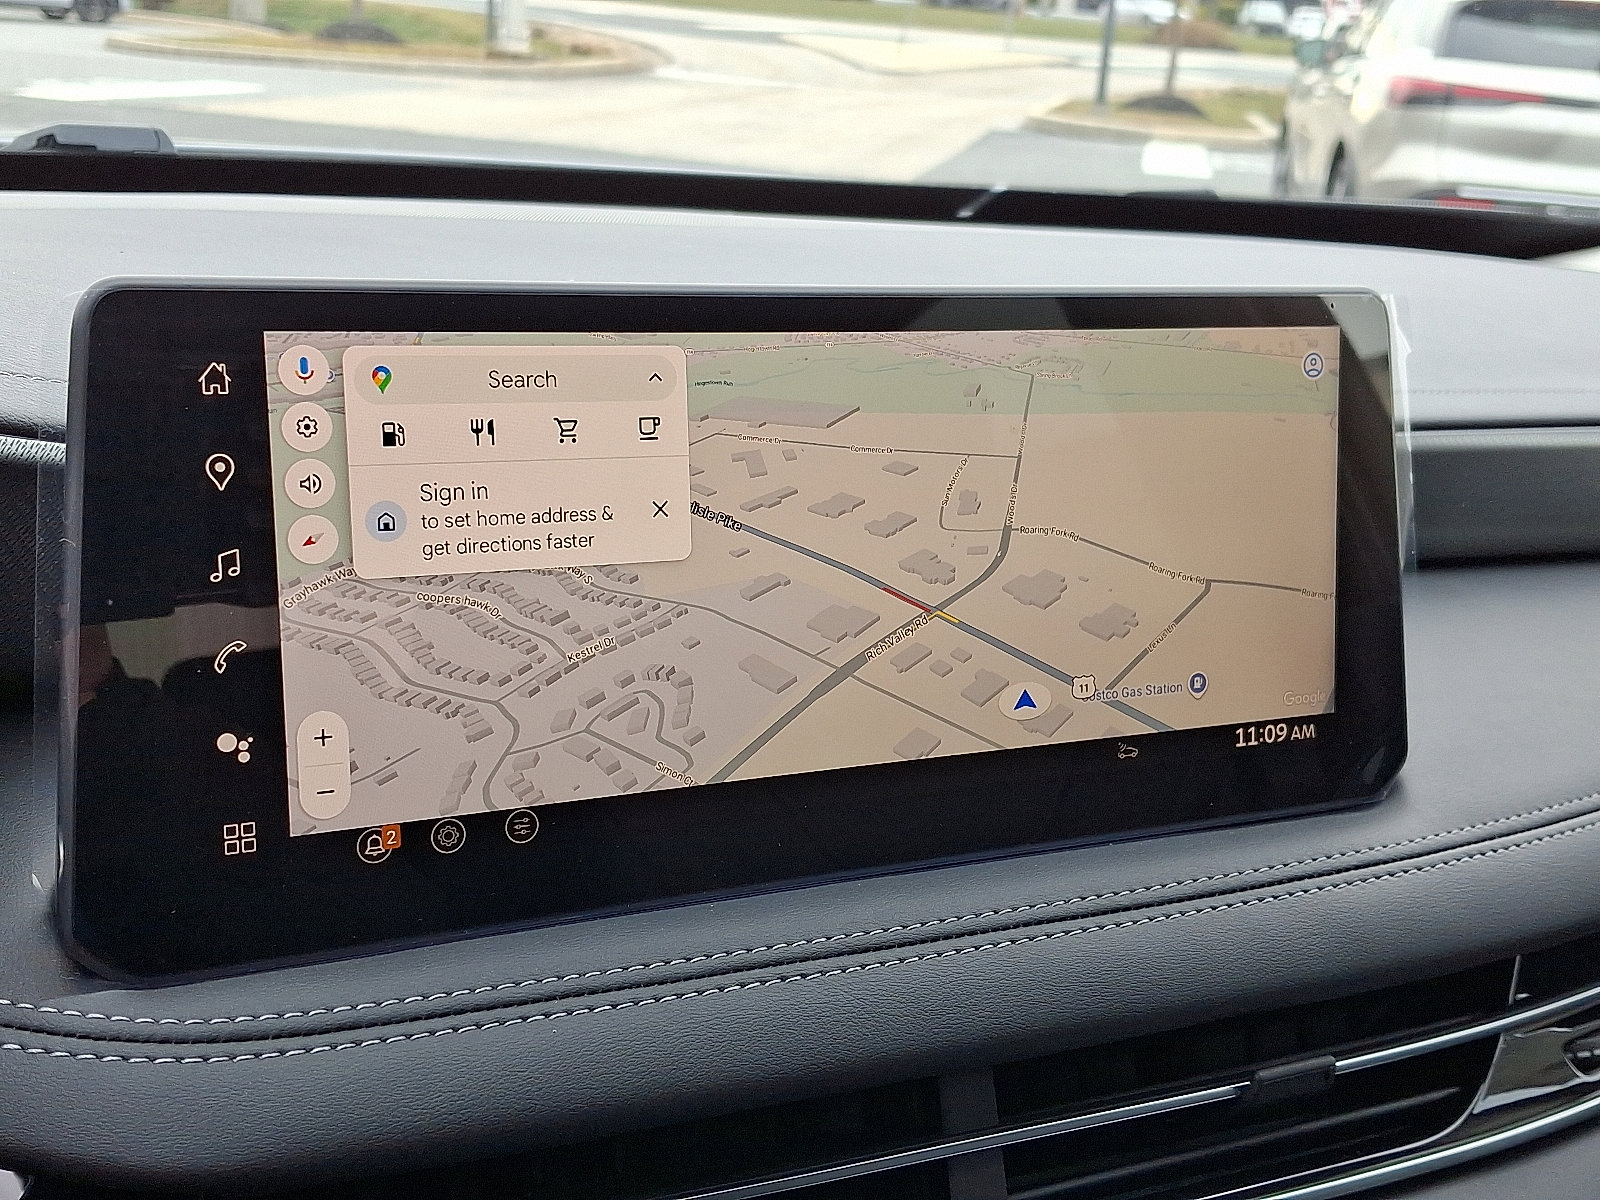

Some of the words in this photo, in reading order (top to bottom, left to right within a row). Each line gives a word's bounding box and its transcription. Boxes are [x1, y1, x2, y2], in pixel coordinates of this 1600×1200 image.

[488, 370, 557, 389] Search
[738, 433, 772, 444] Commerce
[850, 445, 884, 454] Commerce
[420, 483, 464, 506] Sign
[471, 481, 489, 500] in
[942, 493, 950, 506] Sun
[946, 466, 964, 492] Motors
[960, 458, 969, 467] Dr
[422, 514, 438, 530] to
[444, 512, 471, 528] set
[477, 510, 526, 528] home
[531, 506, 597, 524] address
[601, 506, 614, 522] &
[690, 501, 716, 521] lisle
[716, 512, 742, 532] Pike
[1007, 495, 1017, 524] Woods
[1020, 526, 1049, 536] Roaring
[1050, 527, 1069, 539] Fork
[1070, 532, 1080, 542] Rd
[422, 540, 451, 560] get
[456, 536, 542, 556] directions
[546, 533, 594, 551] faster
[584, 576, 593, 584] S
[1149, 562, 1176, 579] Roaring
[1177, 571, 1194, 582] Fork
[1195, 575, 1206, 585] Rd
[283, 574, 334, 609] Grayhawk
[1302, 588, 1328, 600] Roaring
[416, 592, 462, 605] coopers
[463, 596, 492, 612] hawk
[490, 607, 502, 620] Dr
[567, 641, 602, 663] Kestrel
[602, 636, 616, 650] Dr
[866, 642, 888, 662] Rich
[885, 626, 916, 649] Valley
[914, 614, 930, 629] Rd
[1079, 684, 1089, 694] 11
[1122, 686, 1142, 698] Gas
[1145, 683, 1182, 696] Station
[1235, 723, 1288, 748] 11:09
[1290, 723, 1316, 741] AM
[655, 760, 684, 783] Simon
[386, 830, 396, 844] 2
